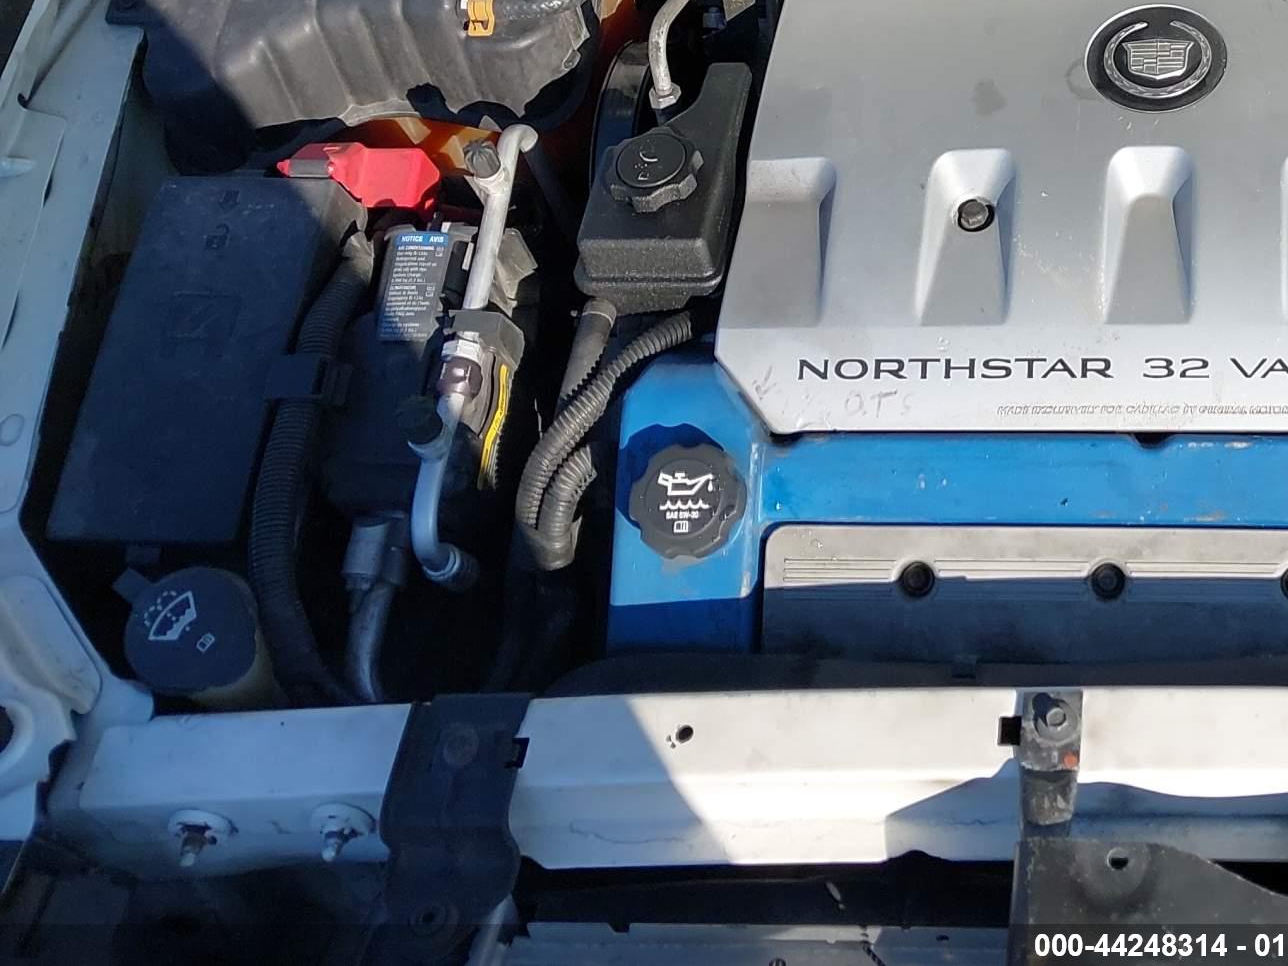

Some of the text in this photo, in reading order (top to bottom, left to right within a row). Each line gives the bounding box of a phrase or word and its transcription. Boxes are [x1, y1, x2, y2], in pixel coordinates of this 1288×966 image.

[401, 235, 423, 243] NOTICE
[797, 357, 1114, 380] NORTHSTAR
[1142, 357, 1210, 379] 32
